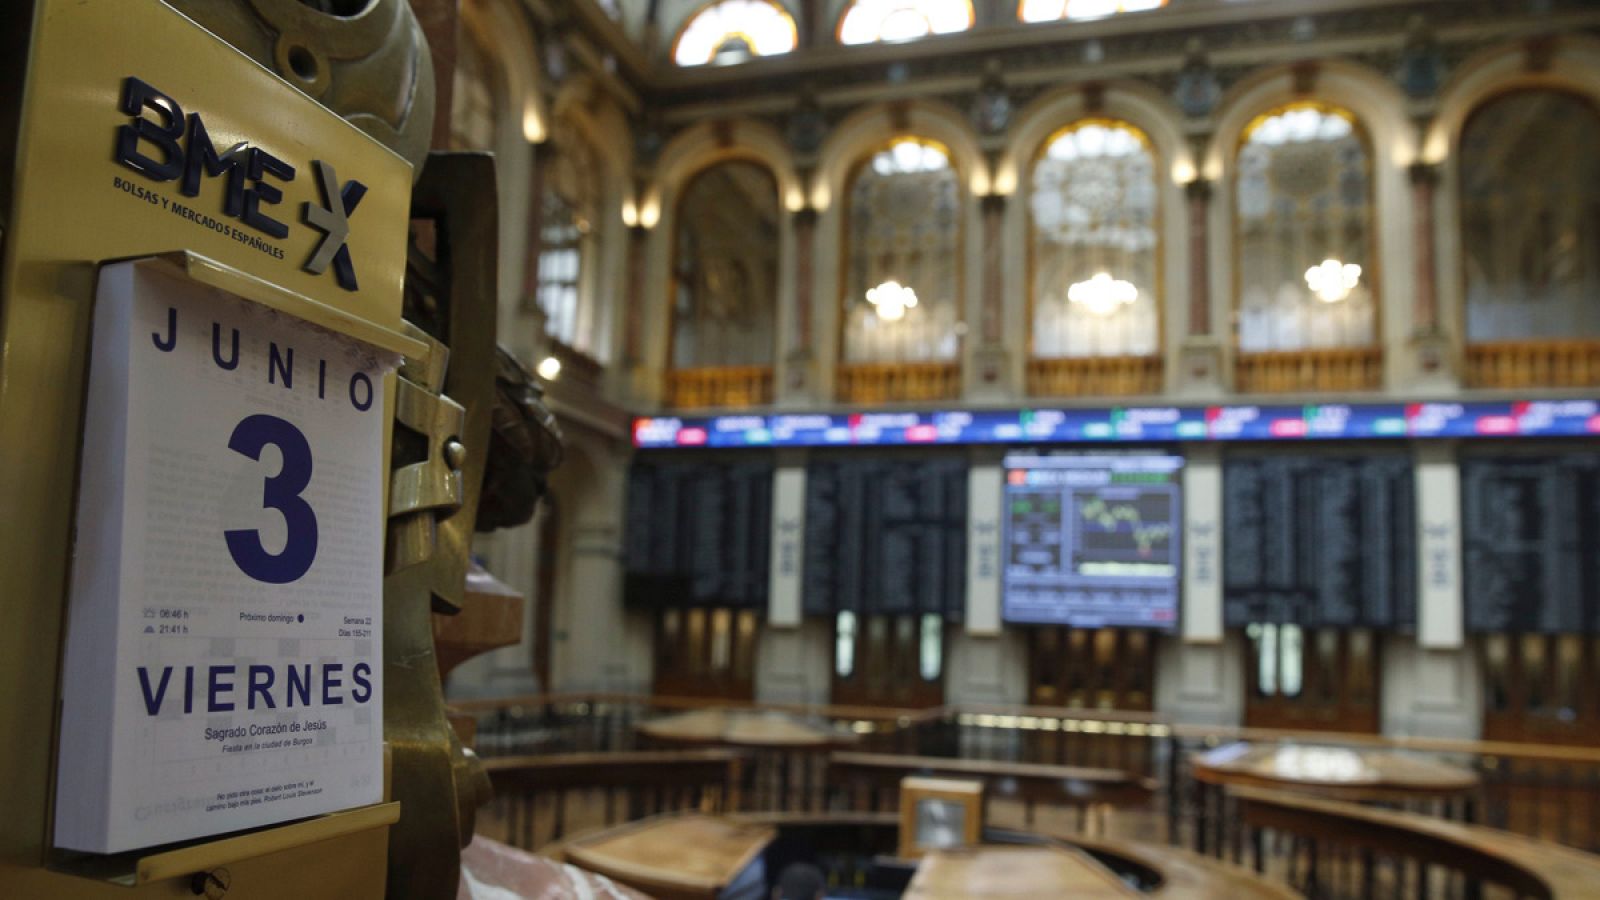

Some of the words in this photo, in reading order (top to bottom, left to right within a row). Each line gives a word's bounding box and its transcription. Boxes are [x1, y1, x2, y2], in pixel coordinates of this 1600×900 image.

[113, 176, 159, 205] BOLSAS
[162, 197, 169, 209] Y
[171, 202, 230, 236] MERCADOS
[231, 228, 285, 260] ESPAÑOLES
[152, 307, 373, 412] JUNIO
[223, 414, 318, 584] 3
[159, 624, 181, 634] 21:41
[239, 611, 266, 622] Próximo
[267, 614, 294, 625] domingo
[343, 616, 365, 625] Semana
[137, 662, 373, 717] VIERNES
[204, 726, 246, 742] Sagrado
[249, 723, 287, 736] Corazón
[290, 722, 301, 732] de
[302, 719, 327, 731] Jesús
[254, 742, 260, 750] la
[261, 740, 282, 749] ciudad
[283, 739, 291, 747] de
[292, 737, 313, 747] Burgos
